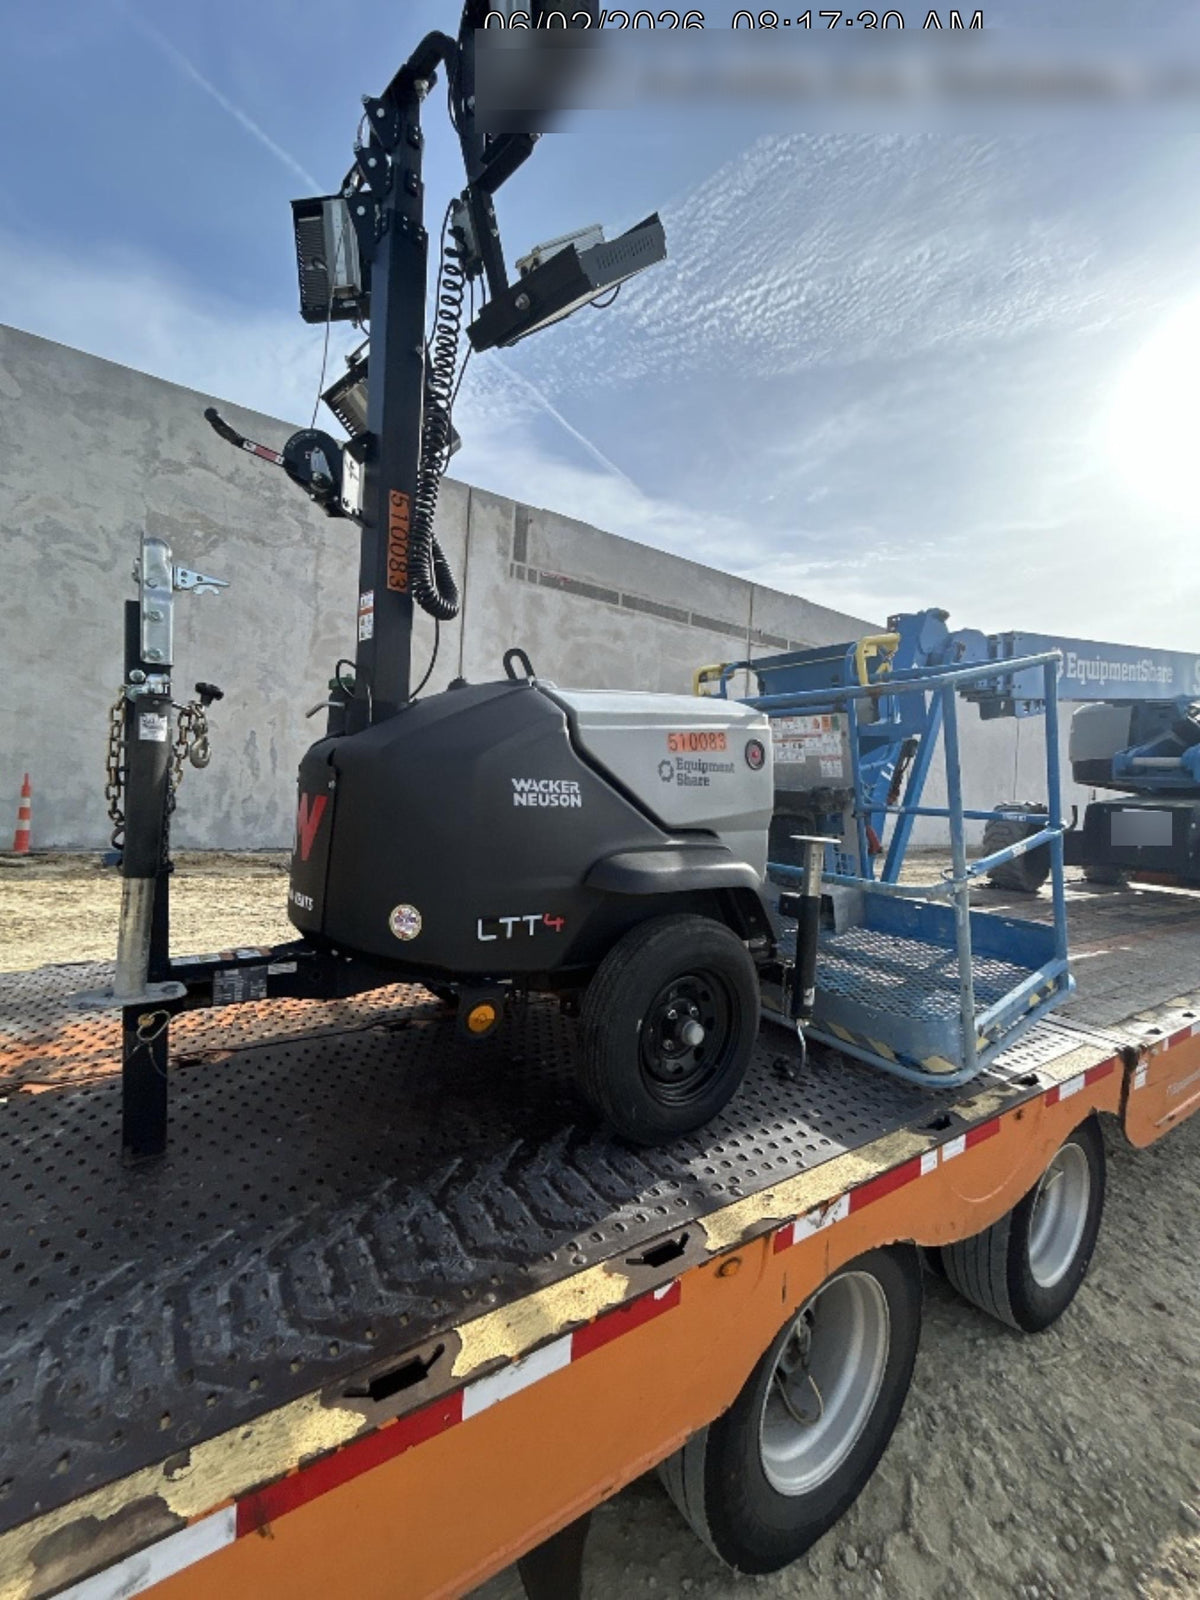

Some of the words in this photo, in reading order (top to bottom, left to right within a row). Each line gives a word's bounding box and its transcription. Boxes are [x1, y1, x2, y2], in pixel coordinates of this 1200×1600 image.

[389, 492, 409, 589] 510083
[1066, 651, 1173, 685] EquipmentShare
[667, 732, 726, 752] 510083
[676, 757, 735, 774] Equipment
[511, 778, 580, 794] WACKER
[677, 773, 710, 786] Share
[513, 793, 582, 807] NEUSON
[477, 913, 565, 941] LTT4
